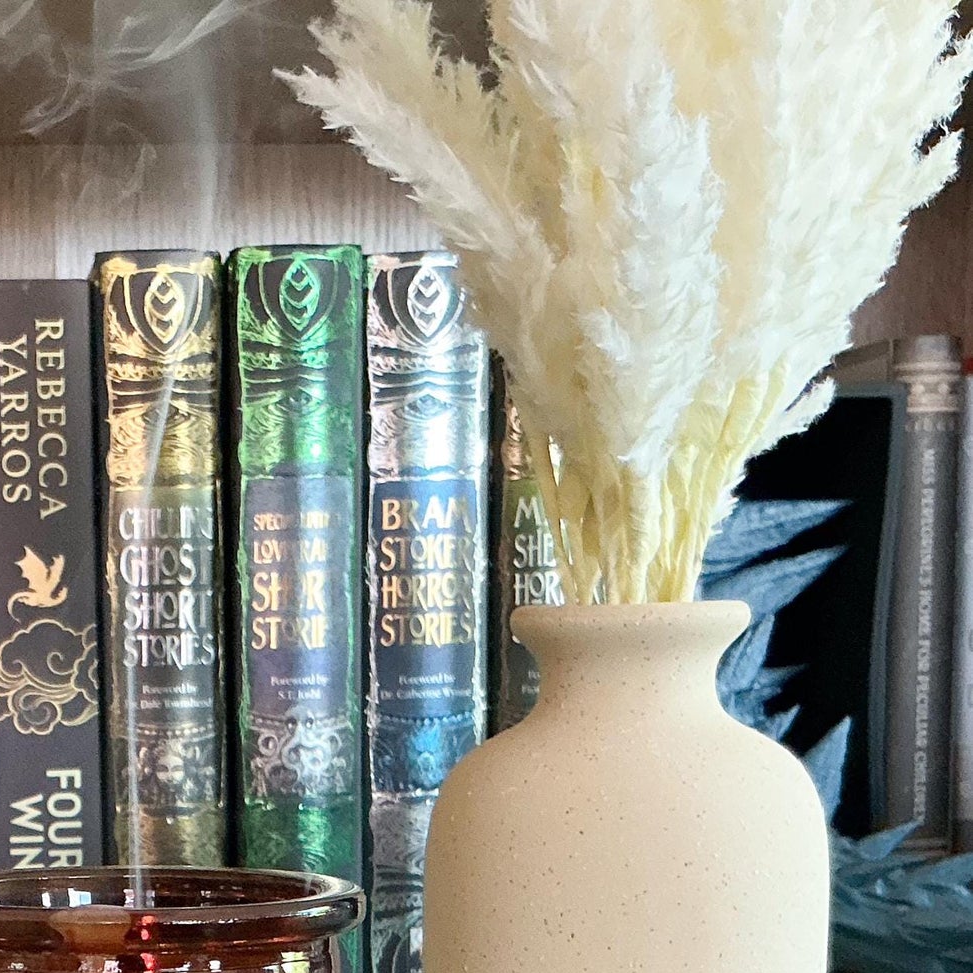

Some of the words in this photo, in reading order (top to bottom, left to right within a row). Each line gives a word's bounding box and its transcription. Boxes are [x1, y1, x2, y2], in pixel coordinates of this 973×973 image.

[34, 318, 68, 520] REBECCA
[381, 495, 471, 533] BRAM
[514, 496, 549, 529] M
[120, 544, 214, 587] GHOST
[379, 534, 475, 573] STOKER
[381, 573, 473, 611] HORROR
[513, 572, 565, 607] HOR
[123, 589, 214, 636] SHORT
[379, 611, 472, 648] STORIES
[123, 631, 215, 670] STORIES
[916, 639, 931, 673] FOR
